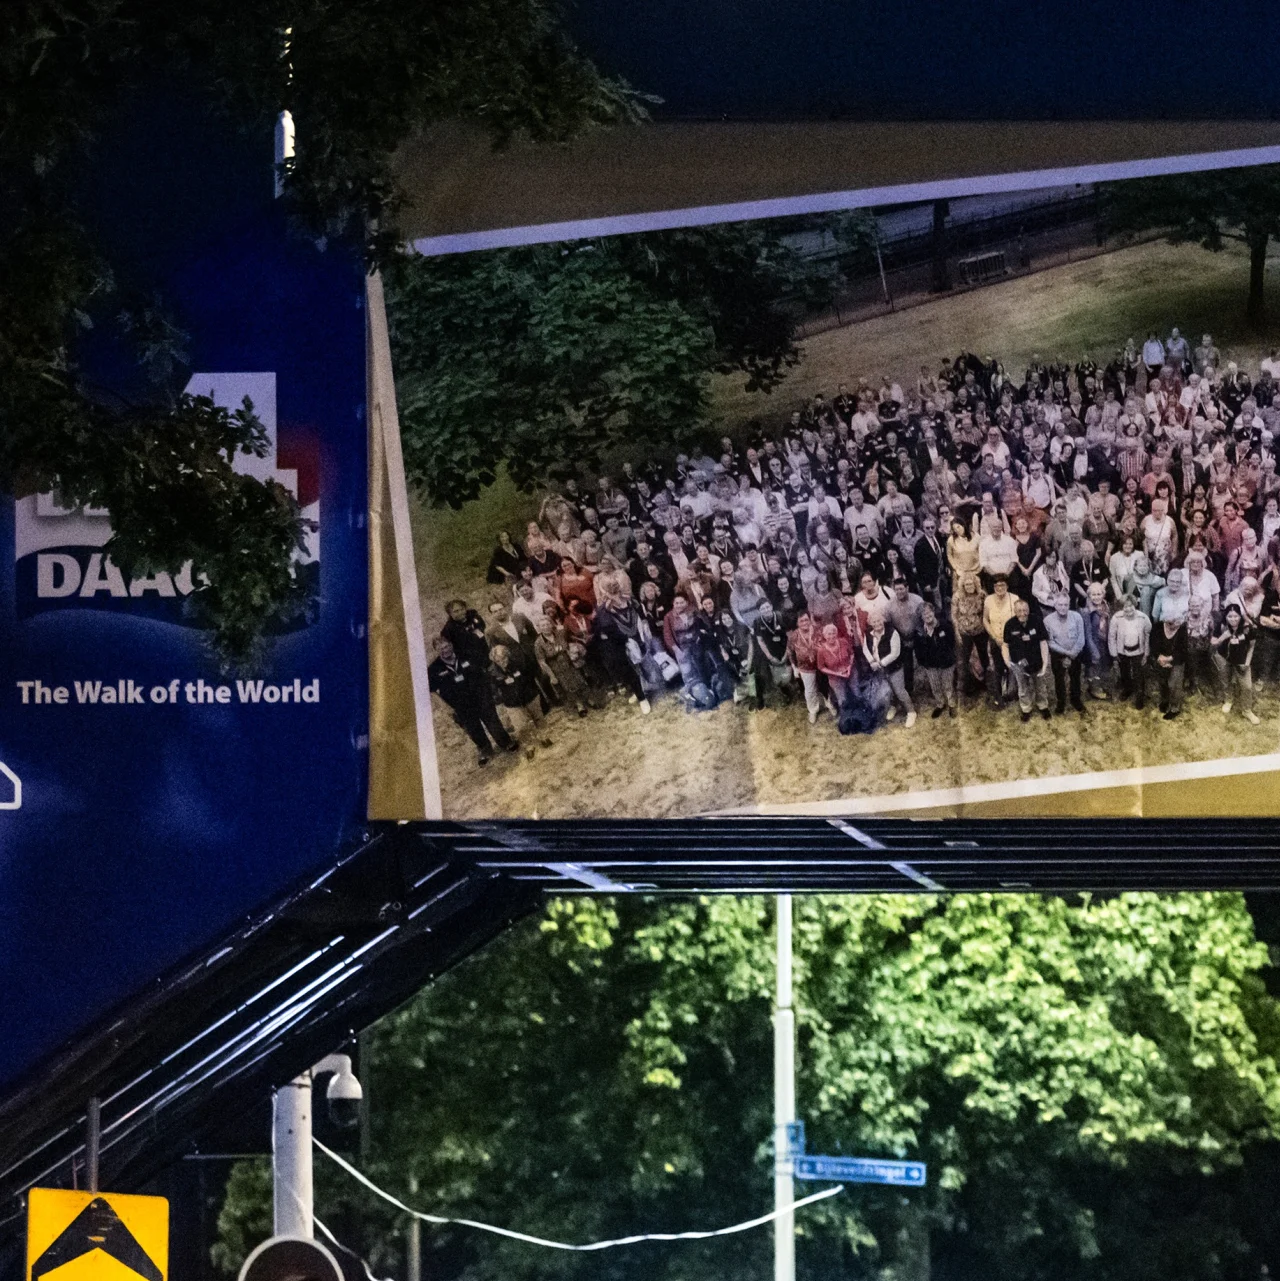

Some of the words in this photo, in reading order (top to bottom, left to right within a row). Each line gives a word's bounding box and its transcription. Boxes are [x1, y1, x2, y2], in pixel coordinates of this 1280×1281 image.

[17, 679, 69, 703] The
[73, 679, 144, 703] Walk
[150, 679, 179, 703] of
[185, 679, 231, 703] the
[236, 679, 320, 703] World
